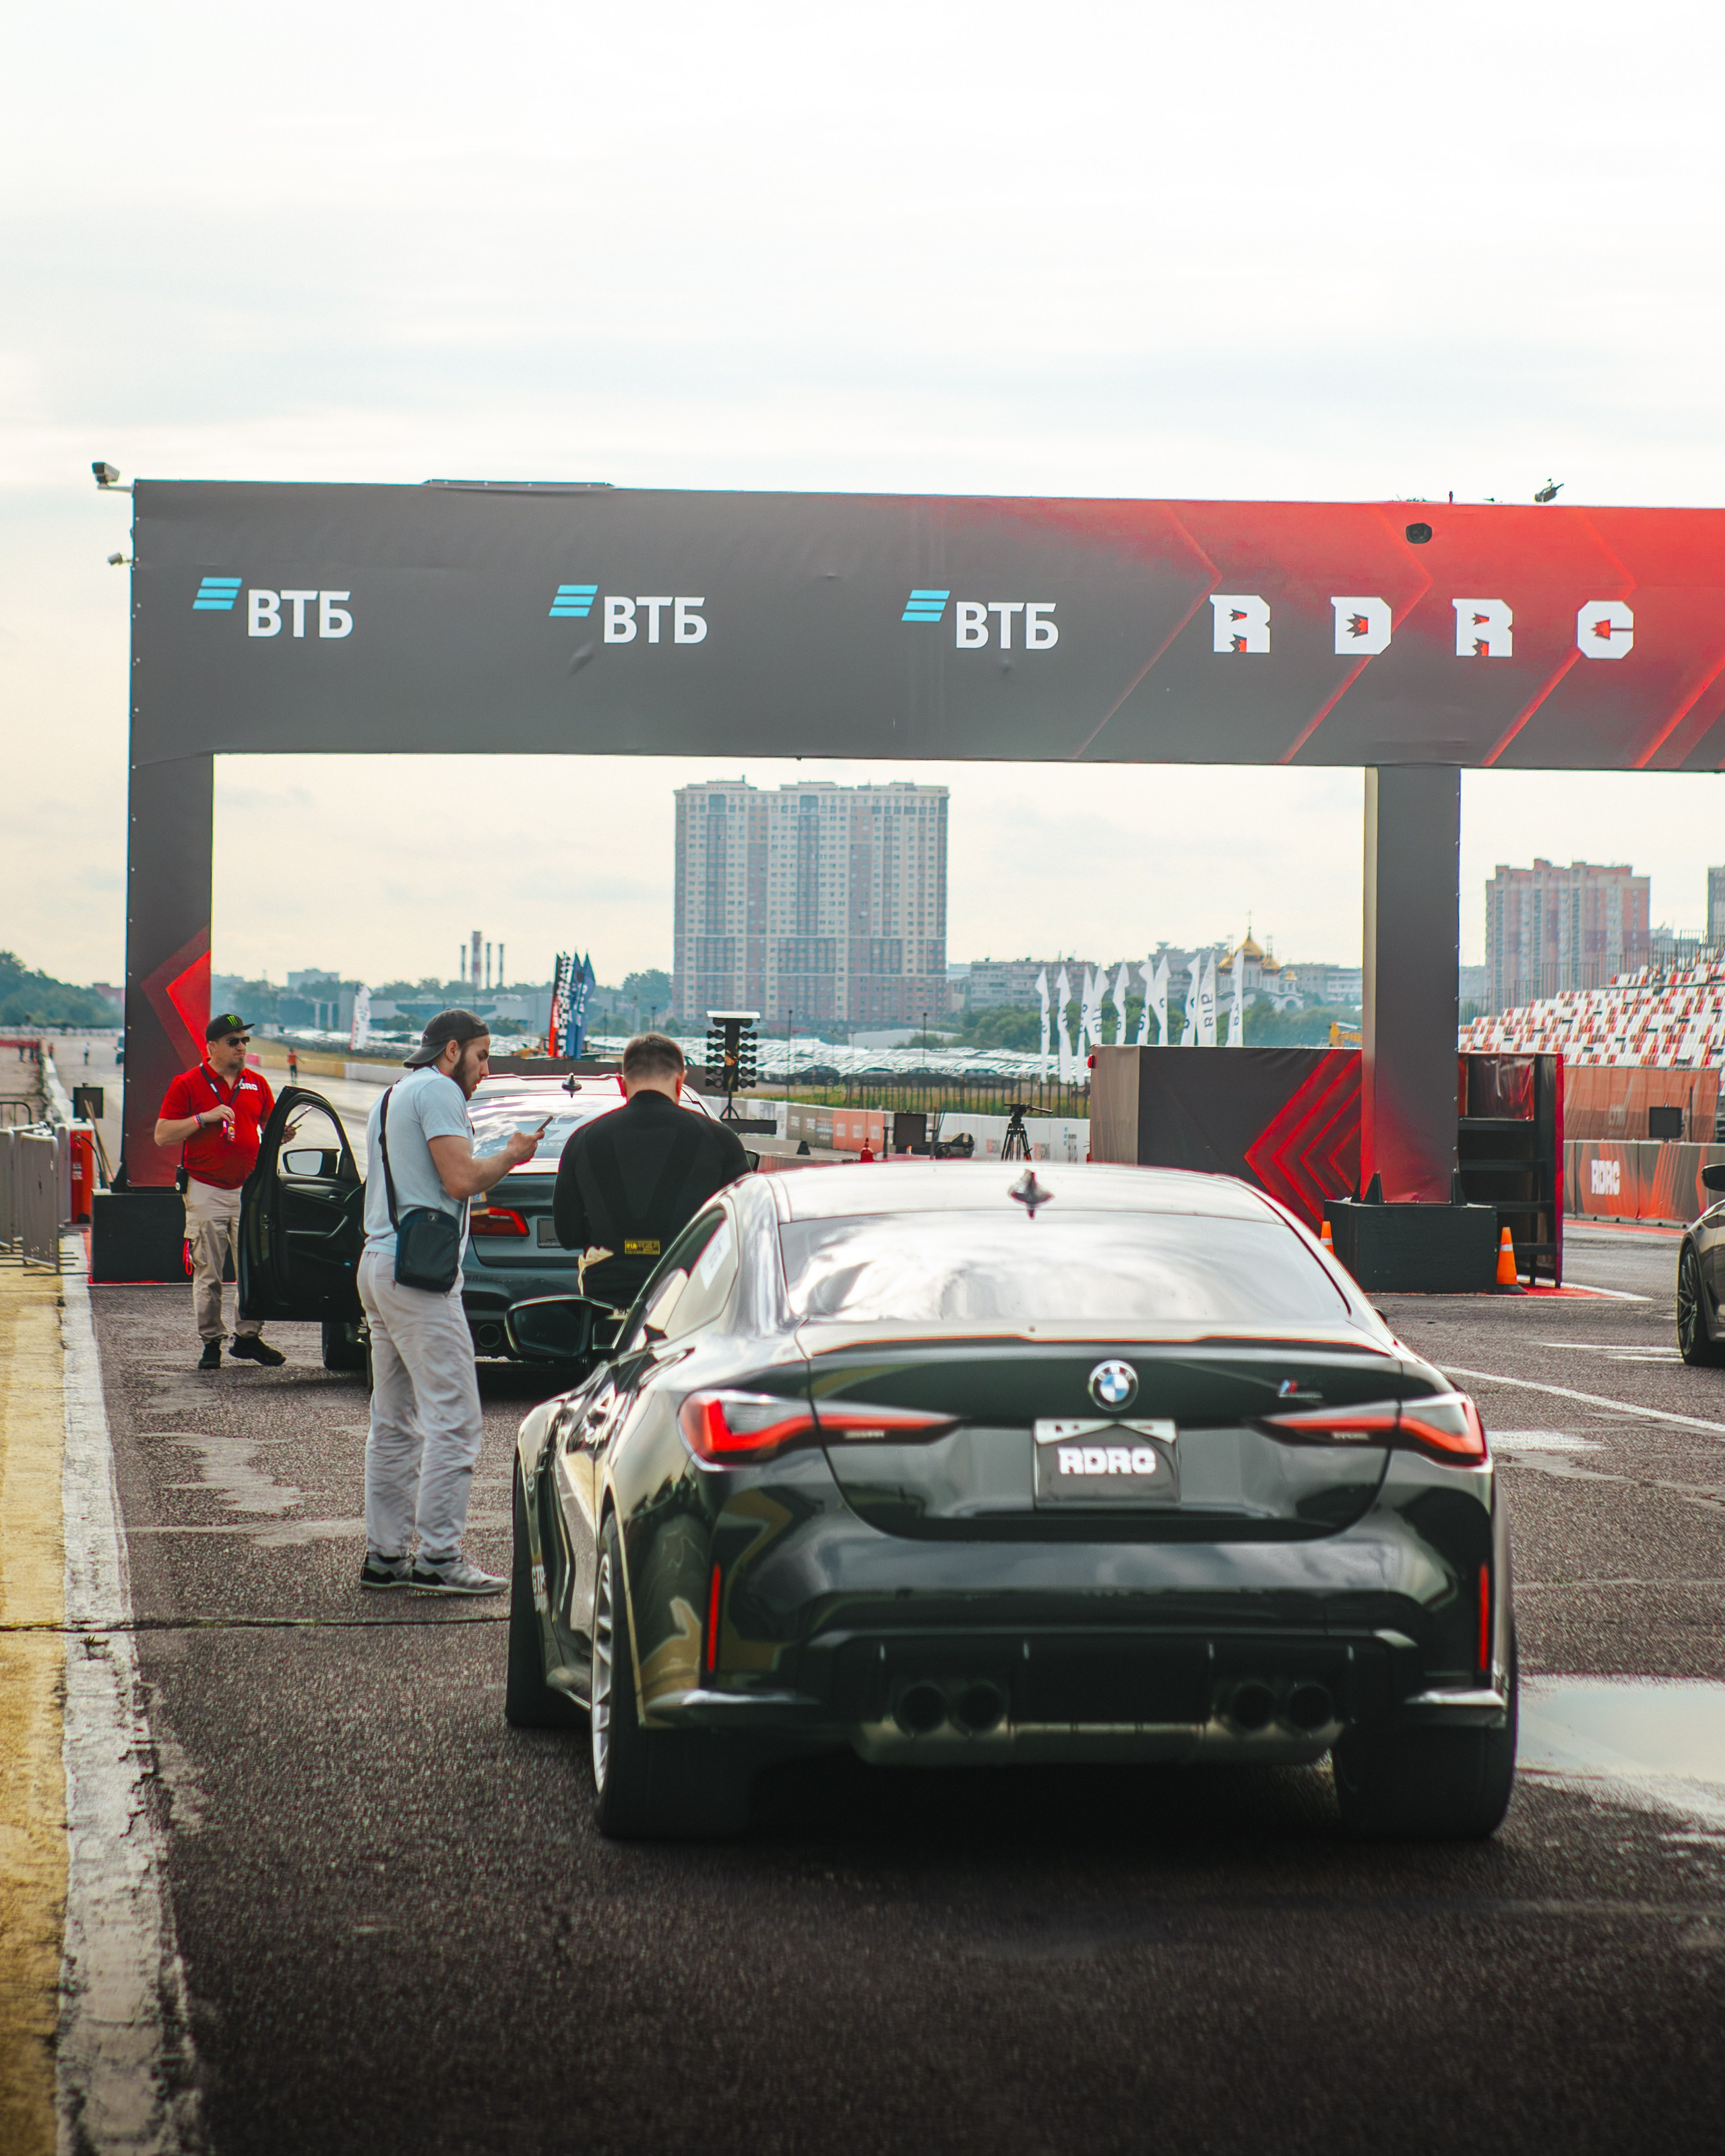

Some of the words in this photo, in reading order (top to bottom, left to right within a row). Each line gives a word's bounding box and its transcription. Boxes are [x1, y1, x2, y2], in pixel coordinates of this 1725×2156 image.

[248, 589, 353, 638] ВТБ
[604, 596, 708, 644] ВТБ
[955, 601, 1059, 650] ВТБ
[234, 1081, 259, 1091] DRC
[1591, 1159, 1621, 1196] RDRC
[1057, 1447, 1157, 1475] RDRC
